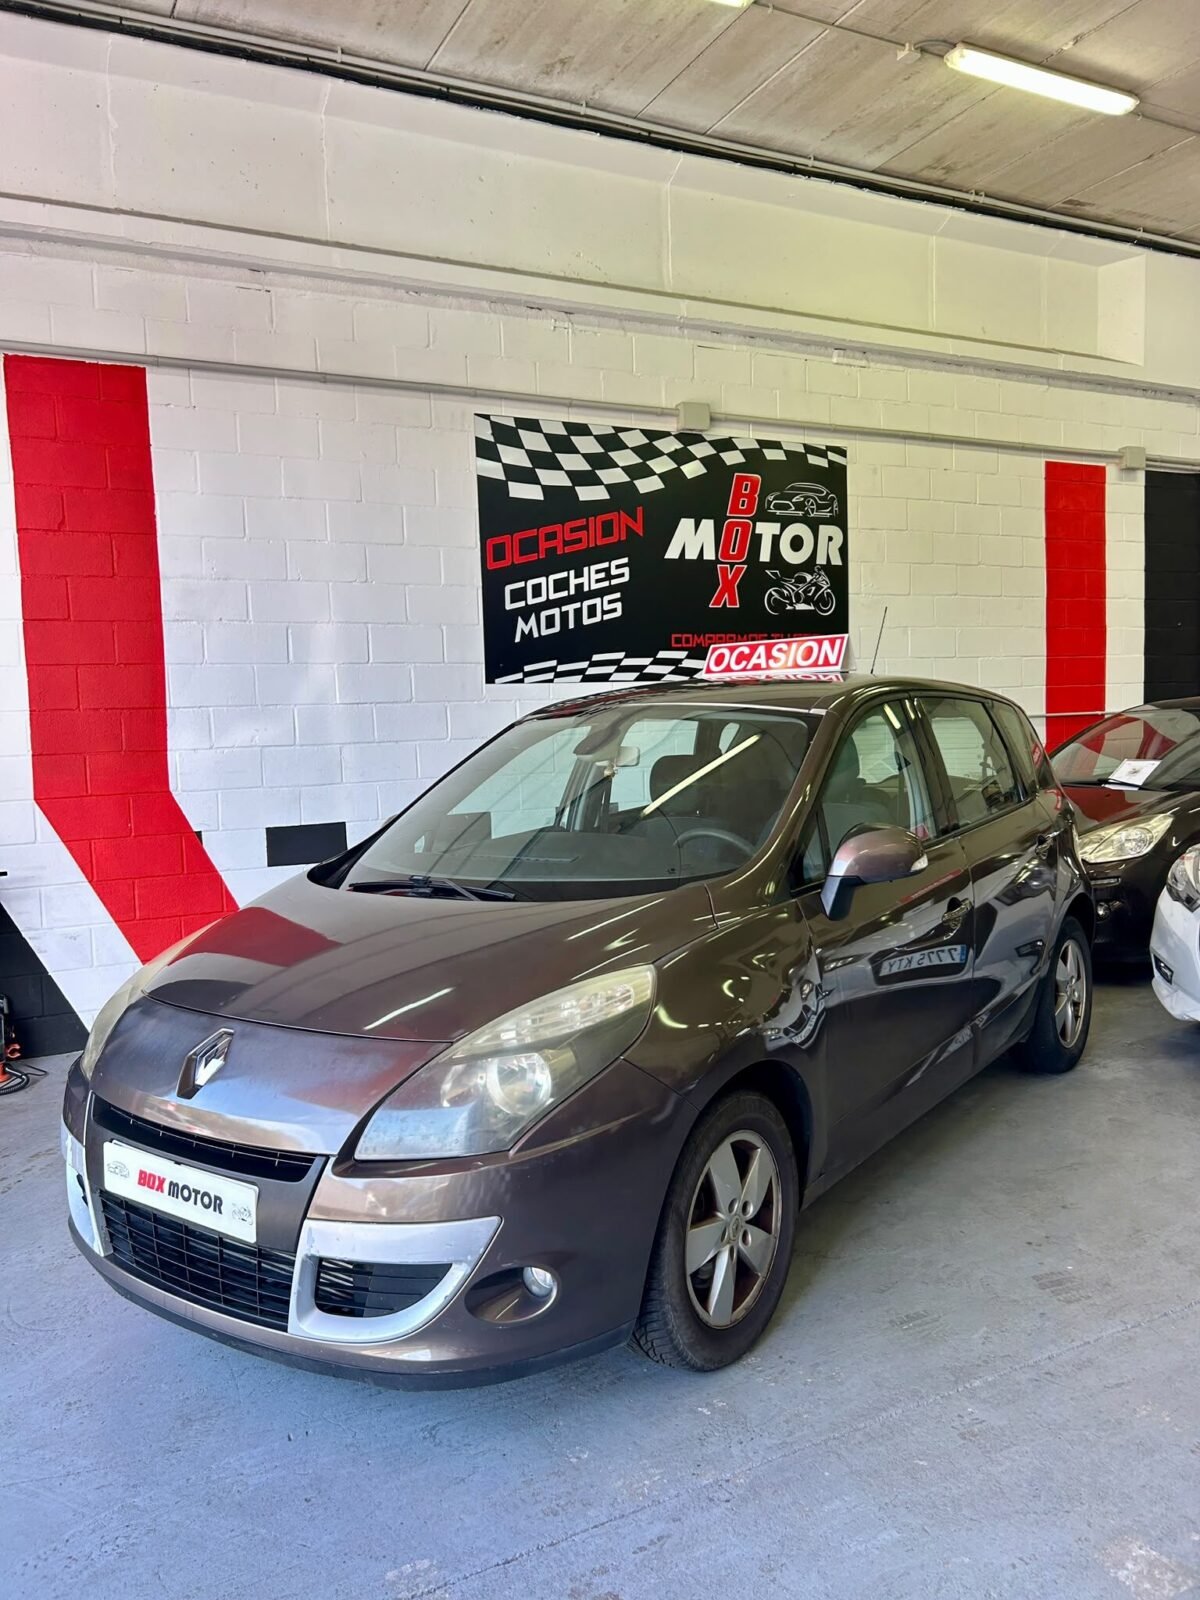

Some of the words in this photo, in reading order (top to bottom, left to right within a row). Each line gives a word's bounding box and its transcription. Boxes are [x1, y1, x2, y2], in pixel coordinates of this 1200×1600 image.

[485, 506, 644, 570] OCASION
[663, 517, 844, 566] MOTOR
[708, 472, 762, 608] BOX
[504, 557, 630, 611] COCHES
[514, 592, 622, 643] MOTOS
[709, 638, 842, 672] OCASION
[137, 1169, 166, 1194] BOX
[168, 1180, 224, 1215] MOTOR
